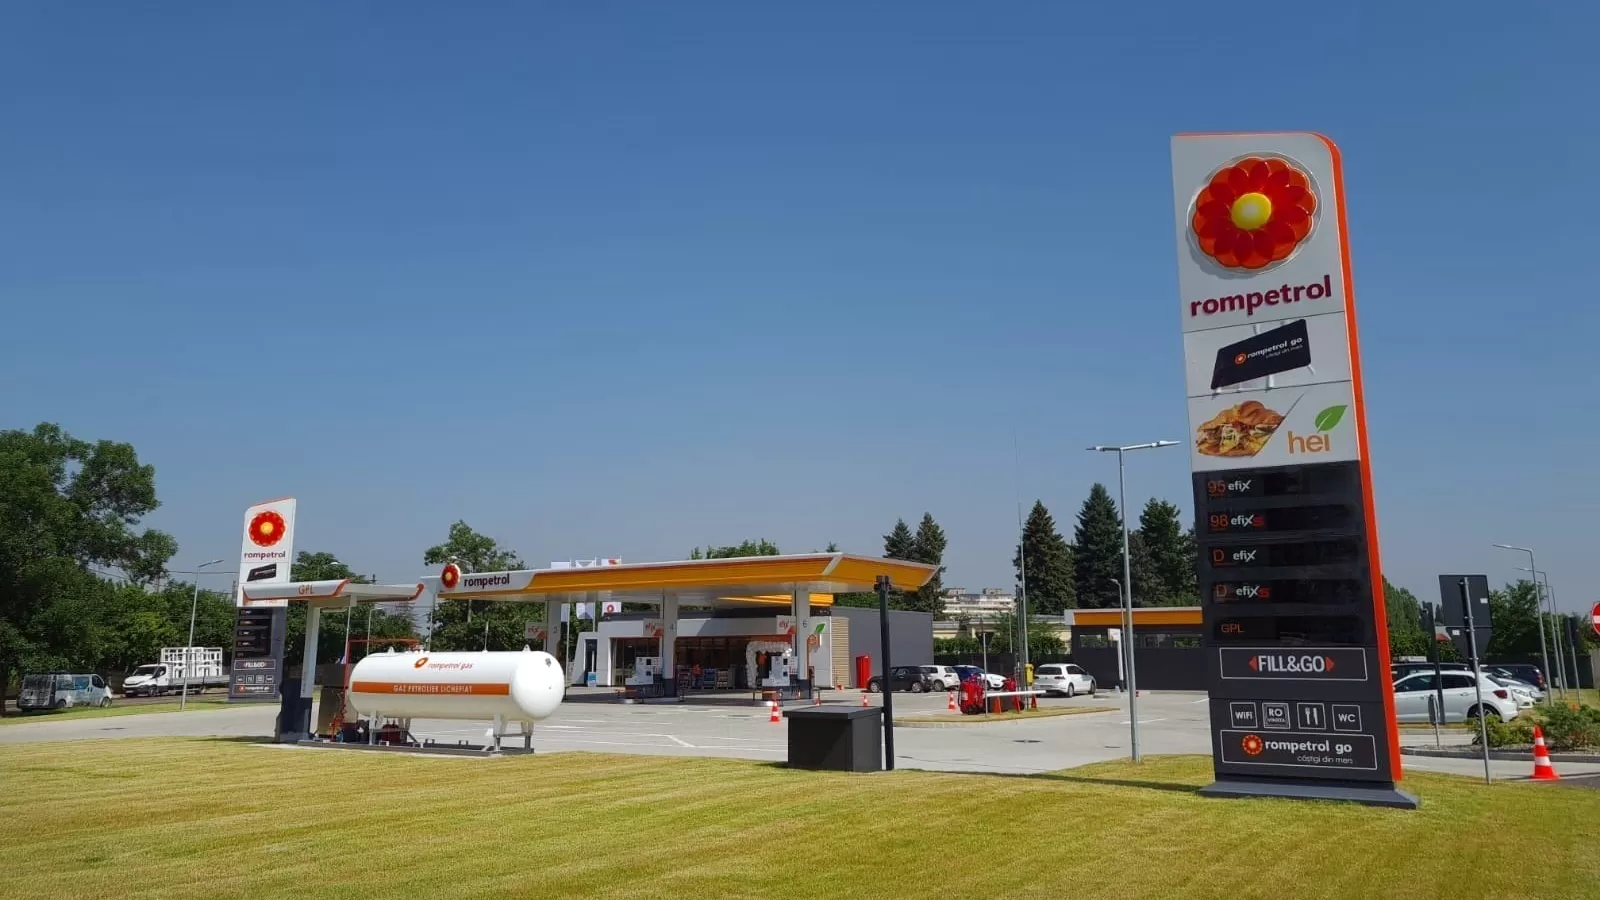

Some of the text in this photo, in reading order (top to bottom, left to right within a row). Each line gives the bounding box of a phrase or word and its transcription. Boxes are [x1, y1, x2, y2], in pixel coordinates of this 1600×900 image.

[1190, 274, 1332, 316] rompetrol
[1247, 340, 1288, 358] rompetrol
[1290, 337, 1303, 346] go
[1288, 430, 1330, 454] hei
[1207, 480, 1226, 493] 95
[1210, 514, 1229, 528] 98
[244, 550, 286, 560] rompetrol
[1213, 549, 1225, 562] D
[464, 573, 510, 589] rompetrol
[1216, 584, 1228, 597] D
[1220, 623, 1245, 633] GPL
[1258, 655, 1326, 673] FILL&GO
[393, 684, 407, 692] GAZ
[1268, 708, 1283, 717] RO
[1338, 713, 1356, 723] WC
[1265, 740, 1353, 755] rompetrol go
